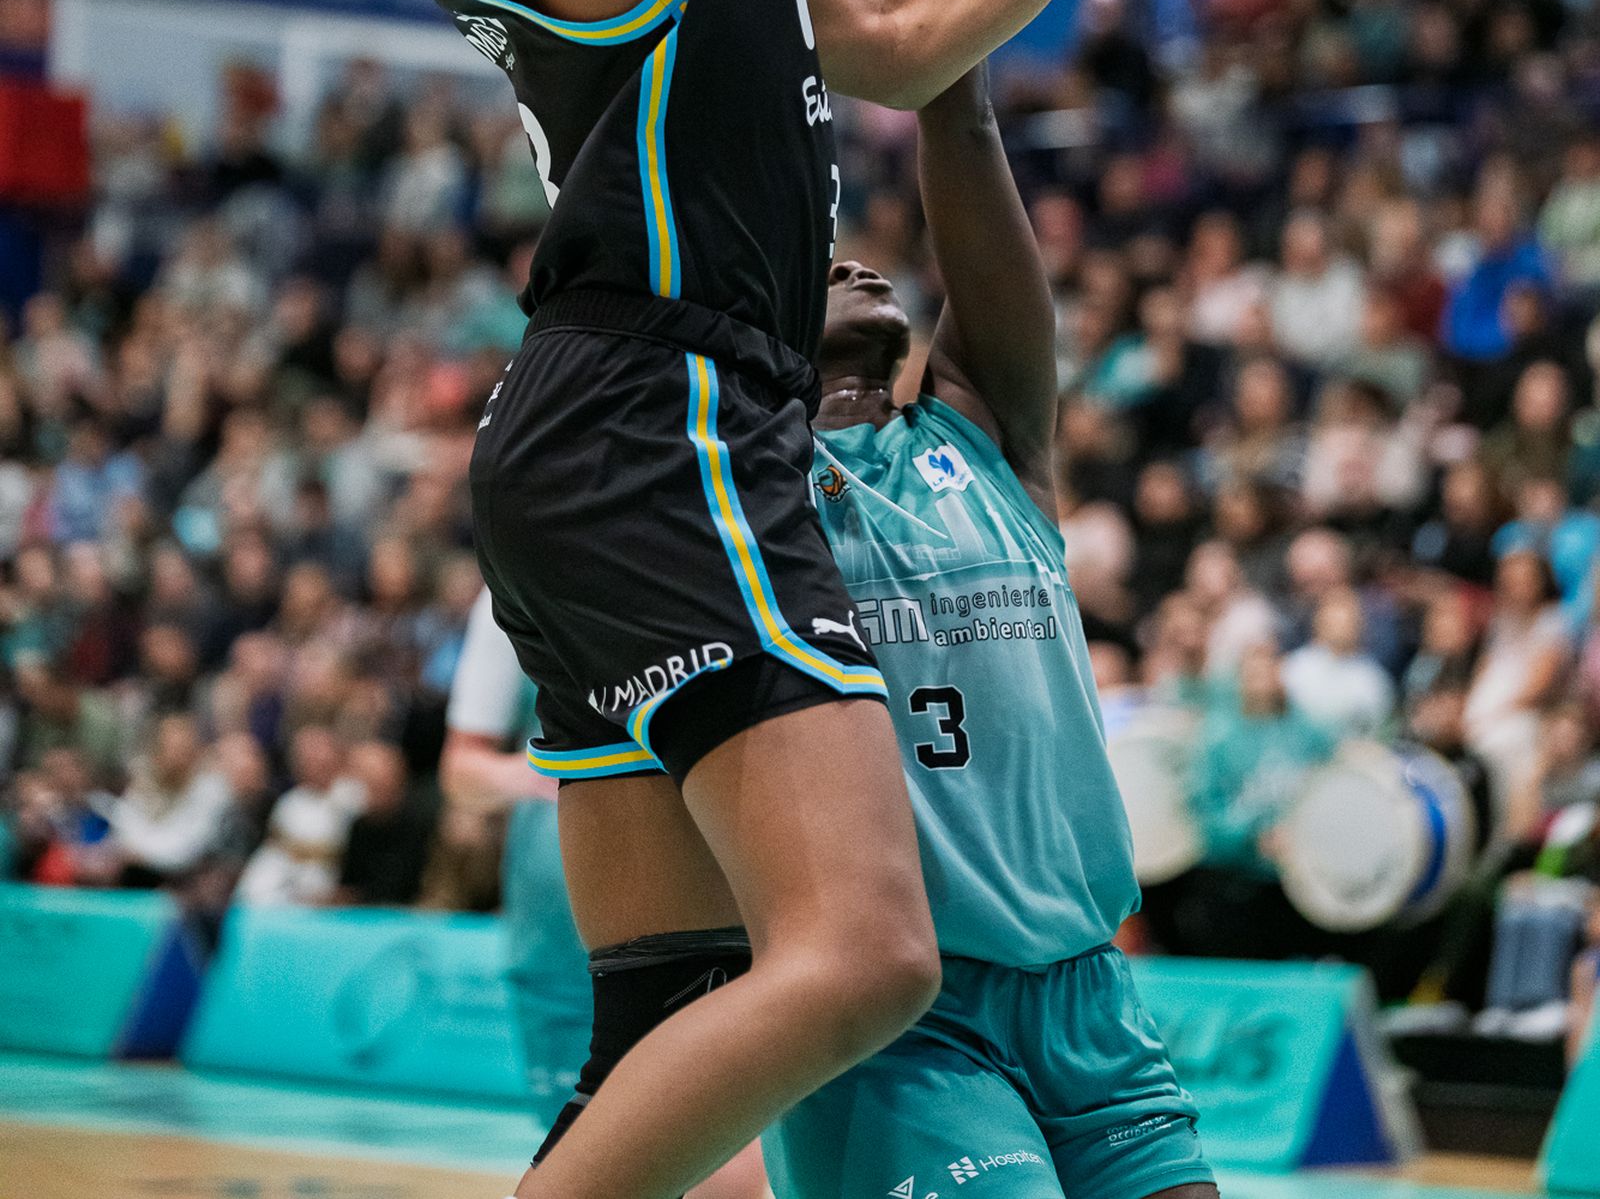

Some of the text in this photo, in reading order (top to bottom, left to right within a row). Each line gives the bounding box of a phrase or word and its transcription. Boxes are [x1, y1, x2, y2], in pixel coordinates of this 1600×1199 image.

[929, 584, 1052, 618] ingeniería
[933, 615, 1057, 647] ambiental
[611, 641, 734, 712] MADRID
[907, 684, 973, 771] 3
